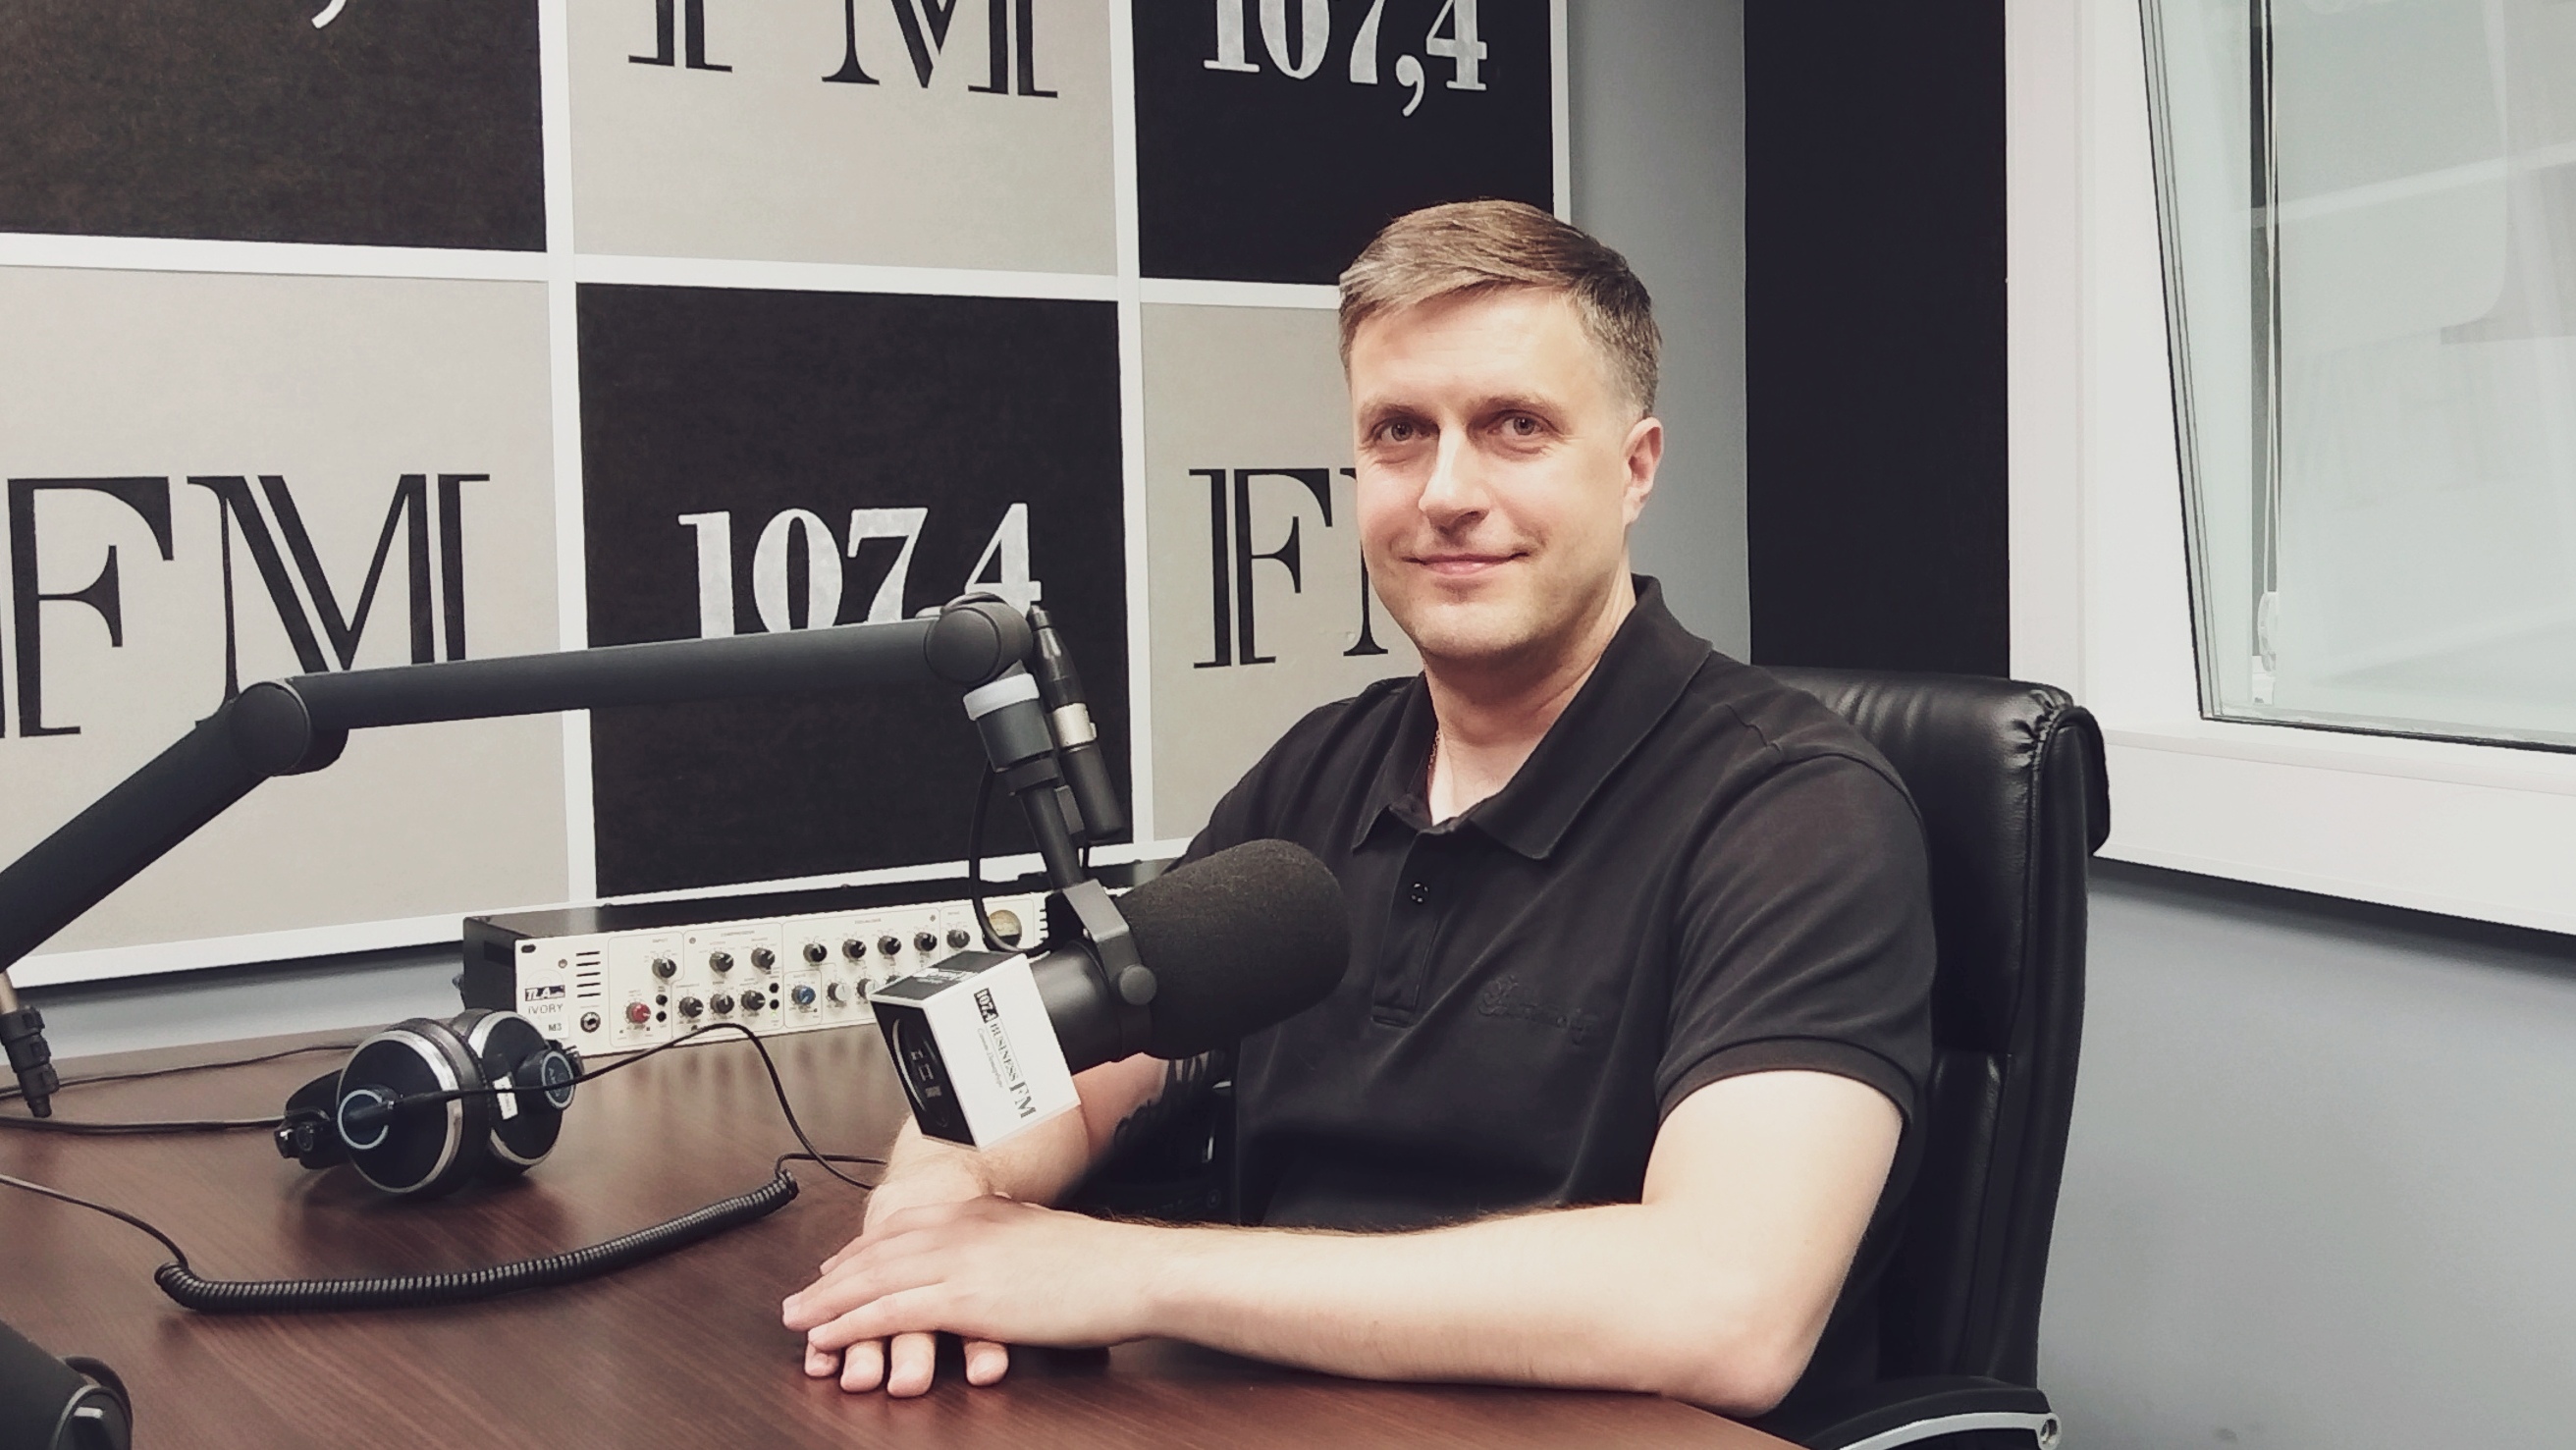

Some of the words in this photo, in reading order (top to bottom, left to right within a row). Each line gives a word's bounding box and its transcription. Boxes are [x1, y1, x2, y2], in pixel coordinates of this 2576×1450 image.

[1203, 0, 1488, 117] 107,4
[0, 473, 490, 738] FM
[677, 502, 1043, 640] 1074
[1189, 467, 1389, 670] F
[990, 1022, 1019, 1082] BUSINESS
[1009, 1081, 1037, 1118] FM
